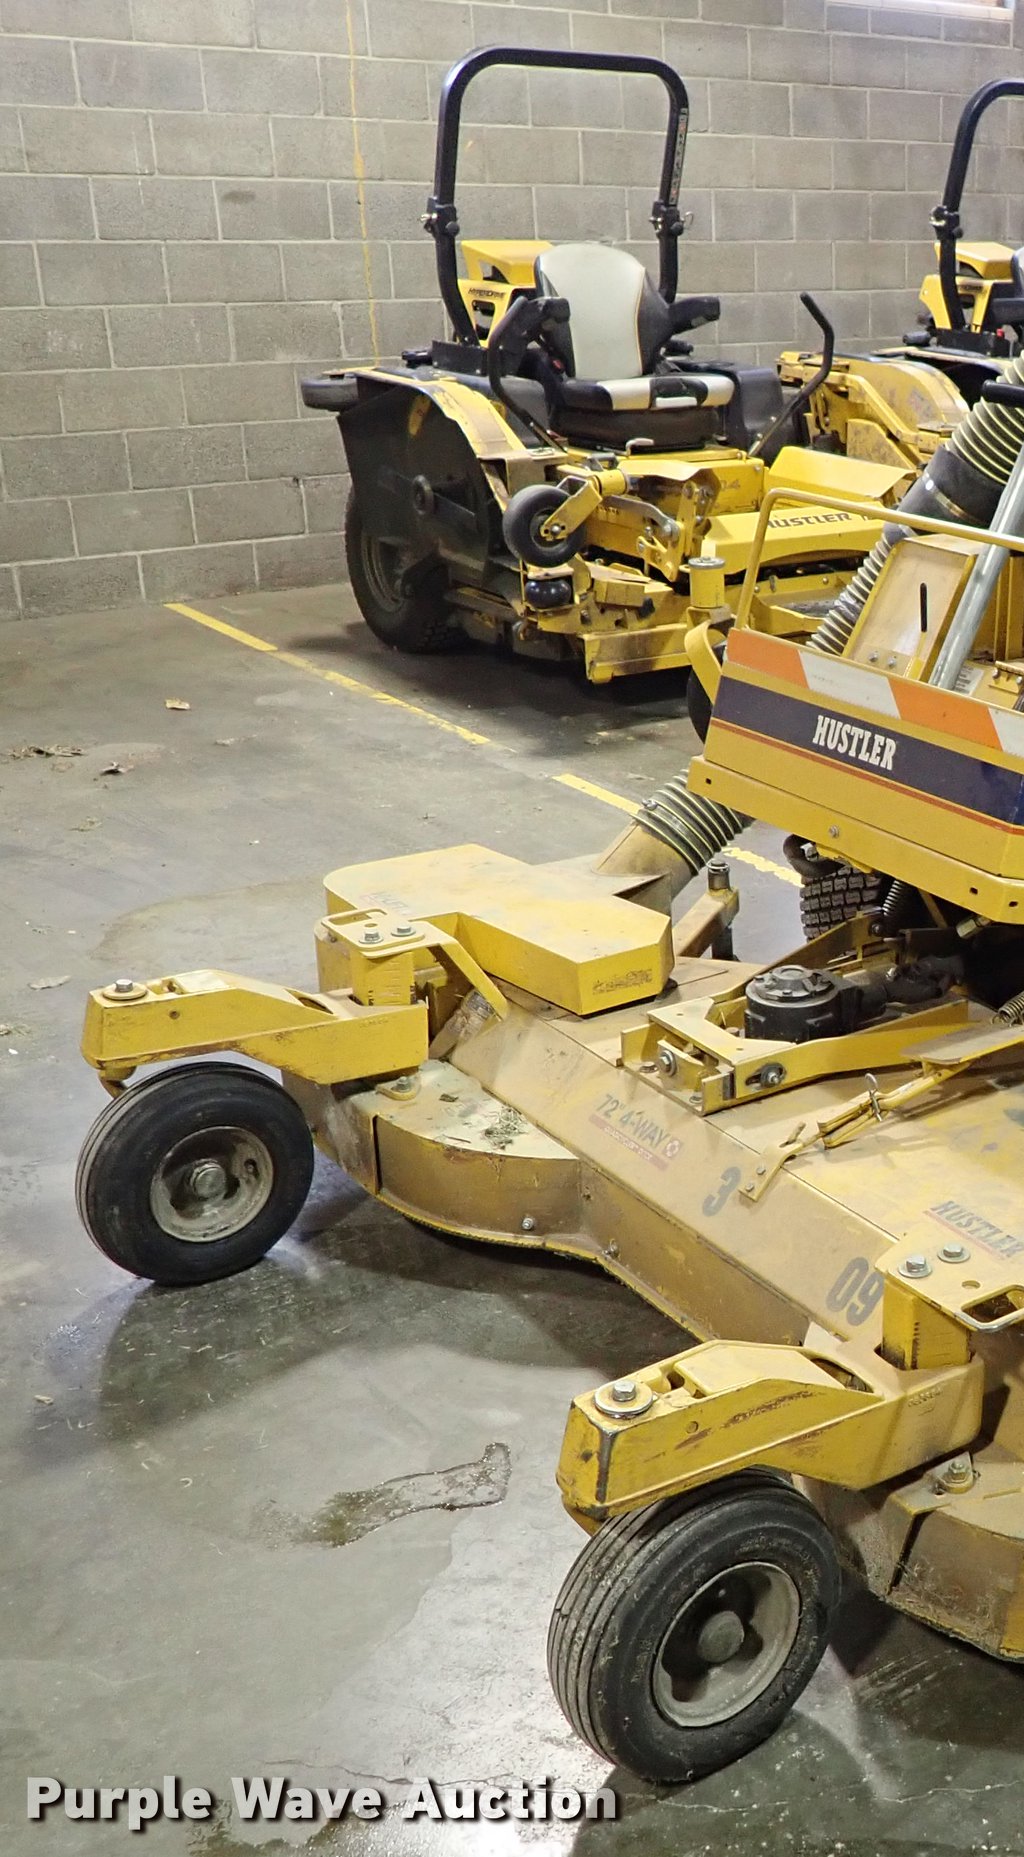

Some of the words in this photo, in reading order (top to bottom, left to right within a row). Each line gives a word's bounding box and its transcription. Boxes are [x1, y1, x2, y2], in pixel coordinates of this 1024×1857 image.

[812, 714, 896, 771] HUSTLER
[702, 1166, 741, 1217] 3
[826, 1256, 886, 1327] 09
